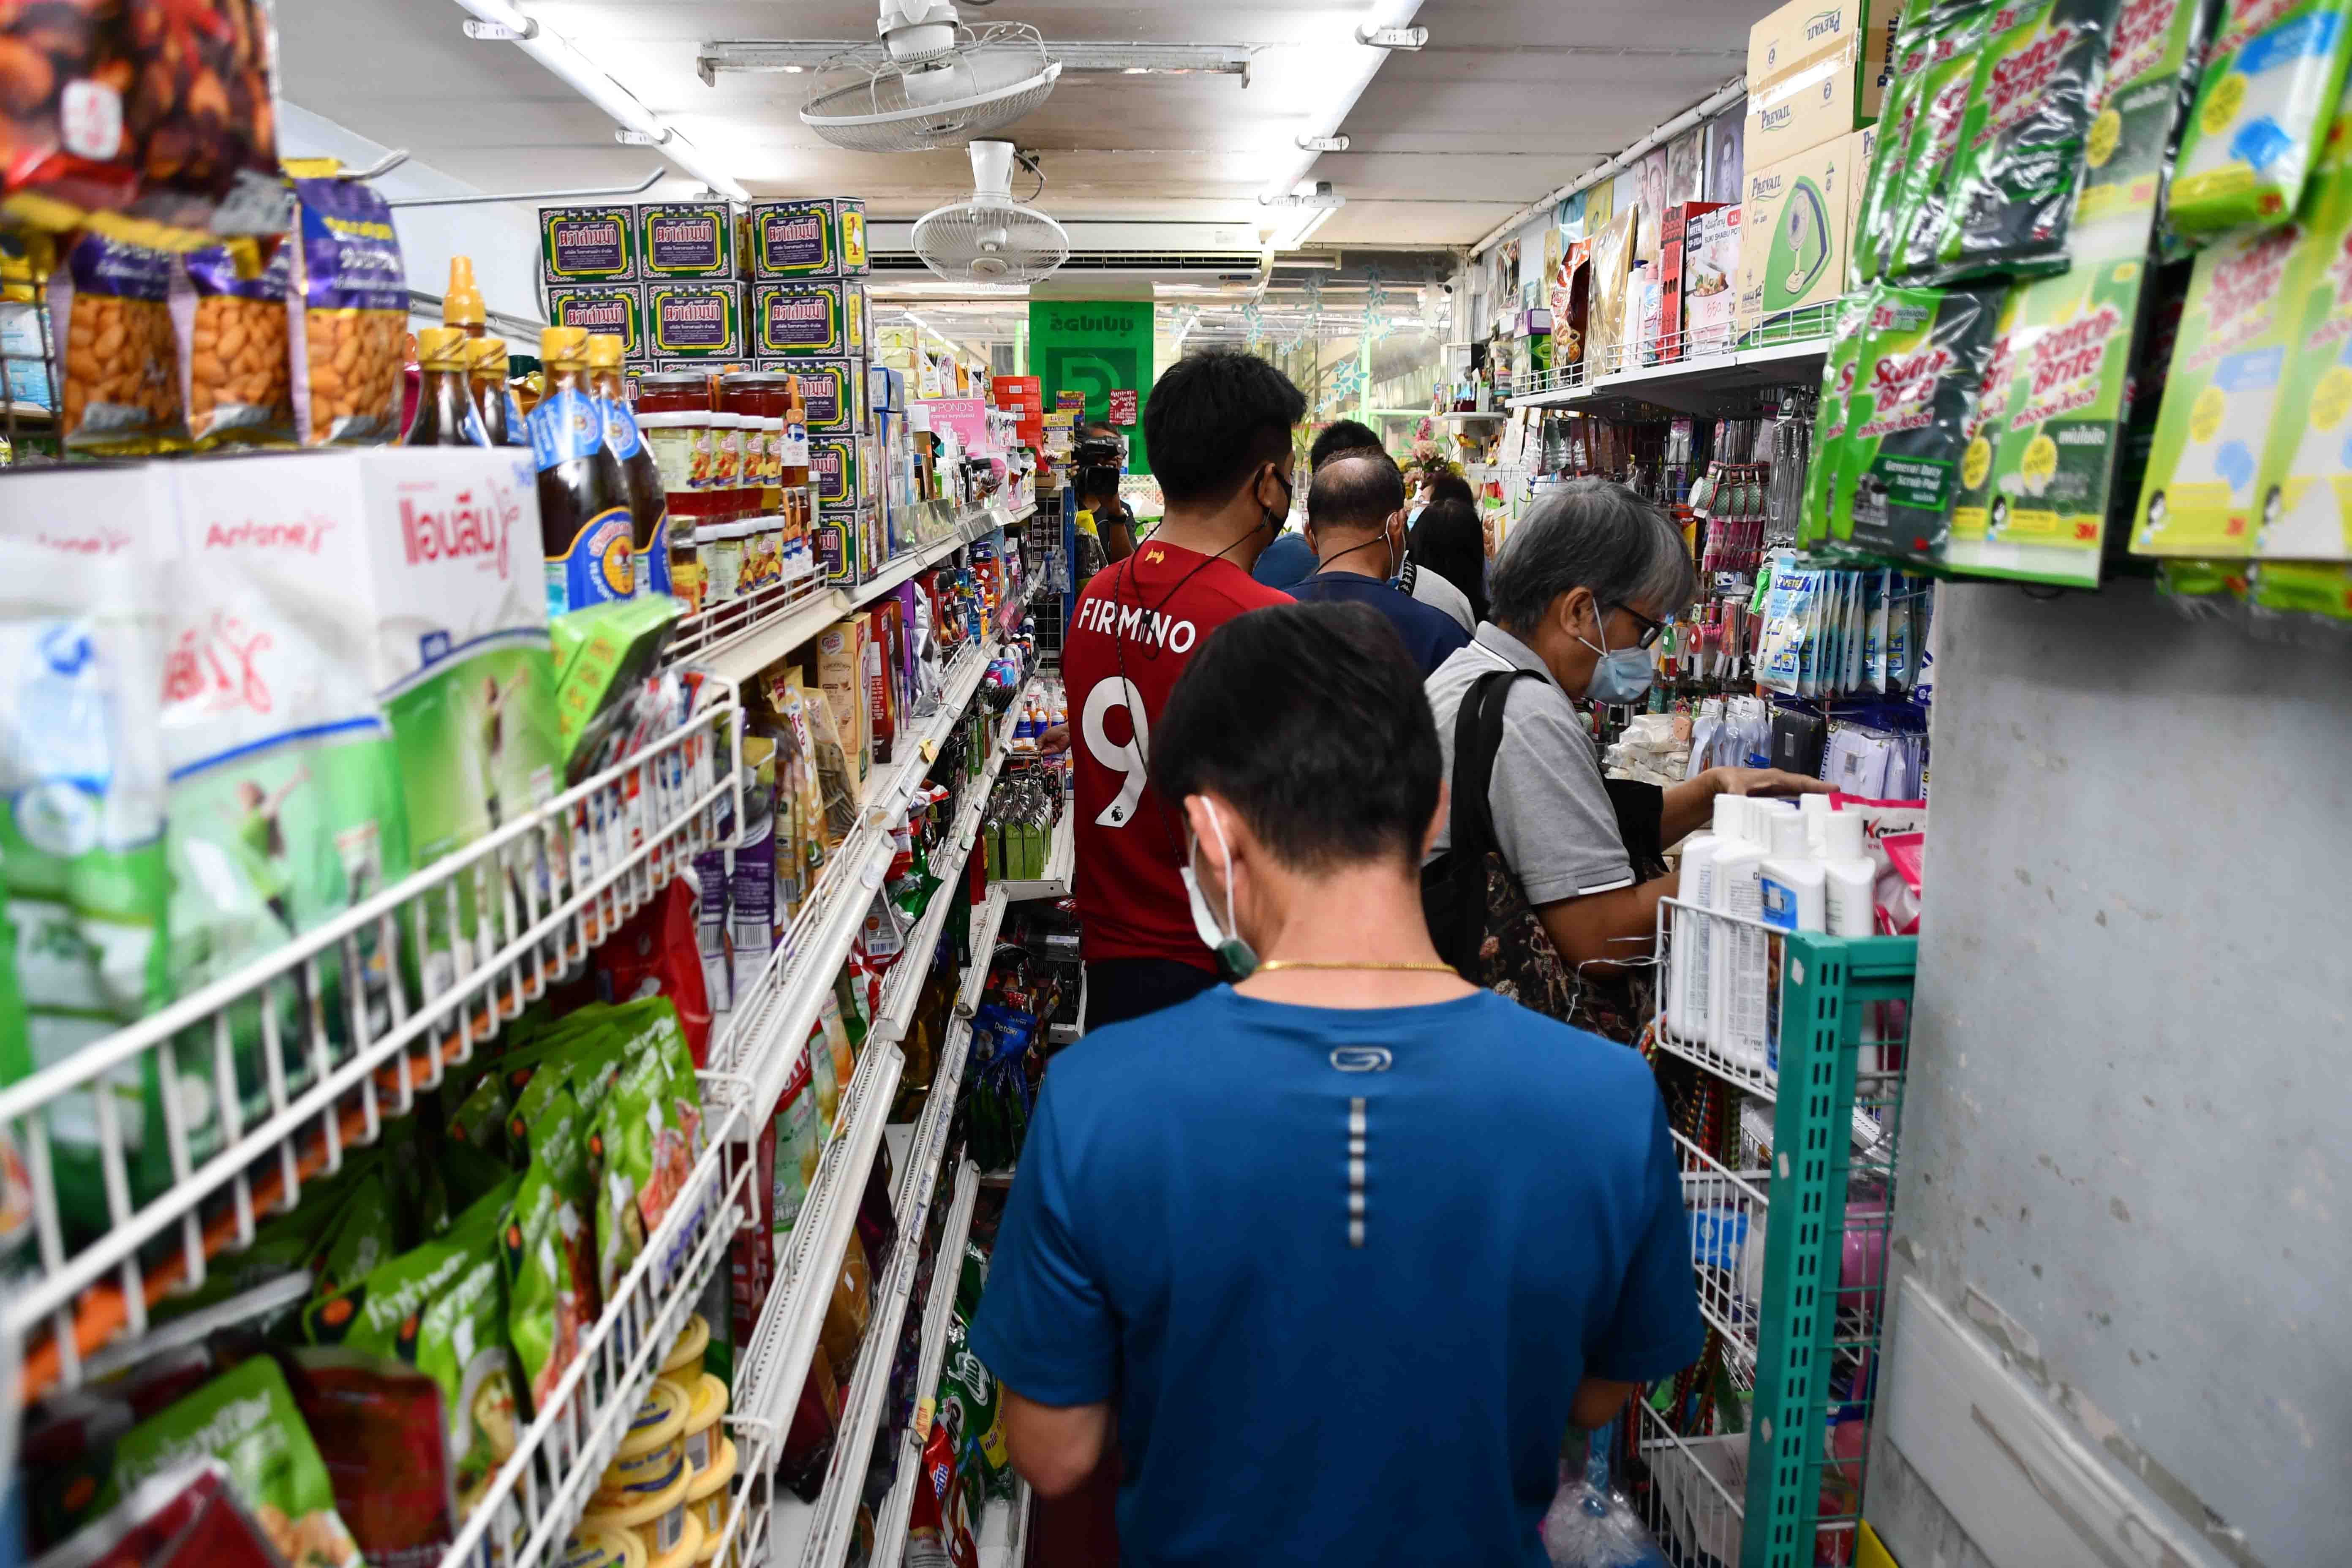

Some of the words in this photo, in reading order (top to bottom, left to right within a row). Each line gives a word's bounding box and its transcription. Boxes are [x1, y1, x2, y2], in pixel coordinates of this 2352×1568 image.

[1808, 11, 1841, 40] PREVAIL
[1761, 105, 1790, 129] PREVAIL
[1752, 175, 1781, 197] PREVAIL
[559, 223, 617, 246] ตราสามม้า
[655, 220, 712, 242] ตราสามม้า
[768, 218, 819, 242] ตราสามม้า
[567, 303, 623, 325] ตราสามม้า
[664, 299, 720, 321] ตราสามม้า
[772, 299, 825, 321] ตราสามม้า
[938, 402, 974, 412] POND'S
[1885, 460, 1920, 474] General
[1921, 464, 1943, 478] Duty
[1897, 474, 1921, 487] Scrub
[1922, 477, 1941, 490] Pad
[399, 491, 497, 567] แอนลีน
[1078, 598, 1196, 653] FIRMINO
[1082, 676, 1149, 828] 9
